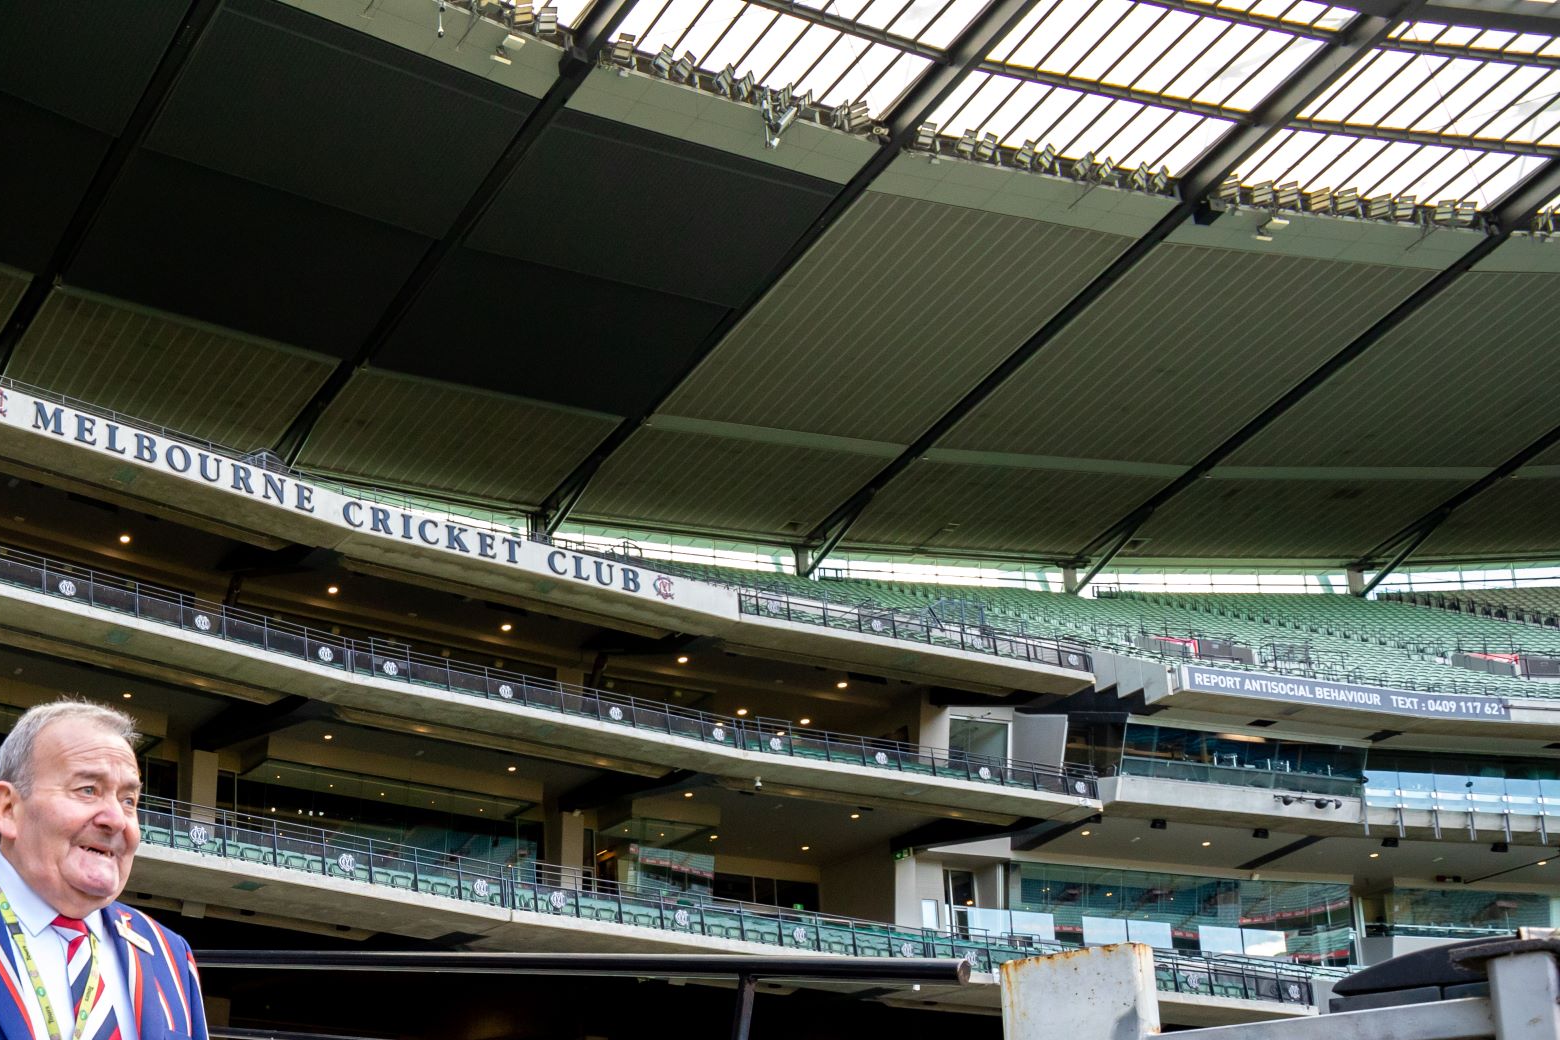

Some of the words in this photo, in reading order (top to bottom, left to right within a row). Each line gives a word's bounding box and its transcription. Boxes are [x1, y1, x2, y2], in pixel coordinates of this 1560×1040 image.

[32, 401, 315, 514] MELBOURNE
[342, 501, 522, 564] CRICKET
[547, 550, 641, 593] CLUB
[1194, 672, 1242, 690] REPORT
[1243, 678, 1314, 699] ANTISOCIAL
[1315, 686, 1382, 706] BEHAVIOUR
[1390, 695, 1419, 710] TEXT
[1427, 699, 1457, 713] 0409
[1460, 701, 1482, 714] 117
